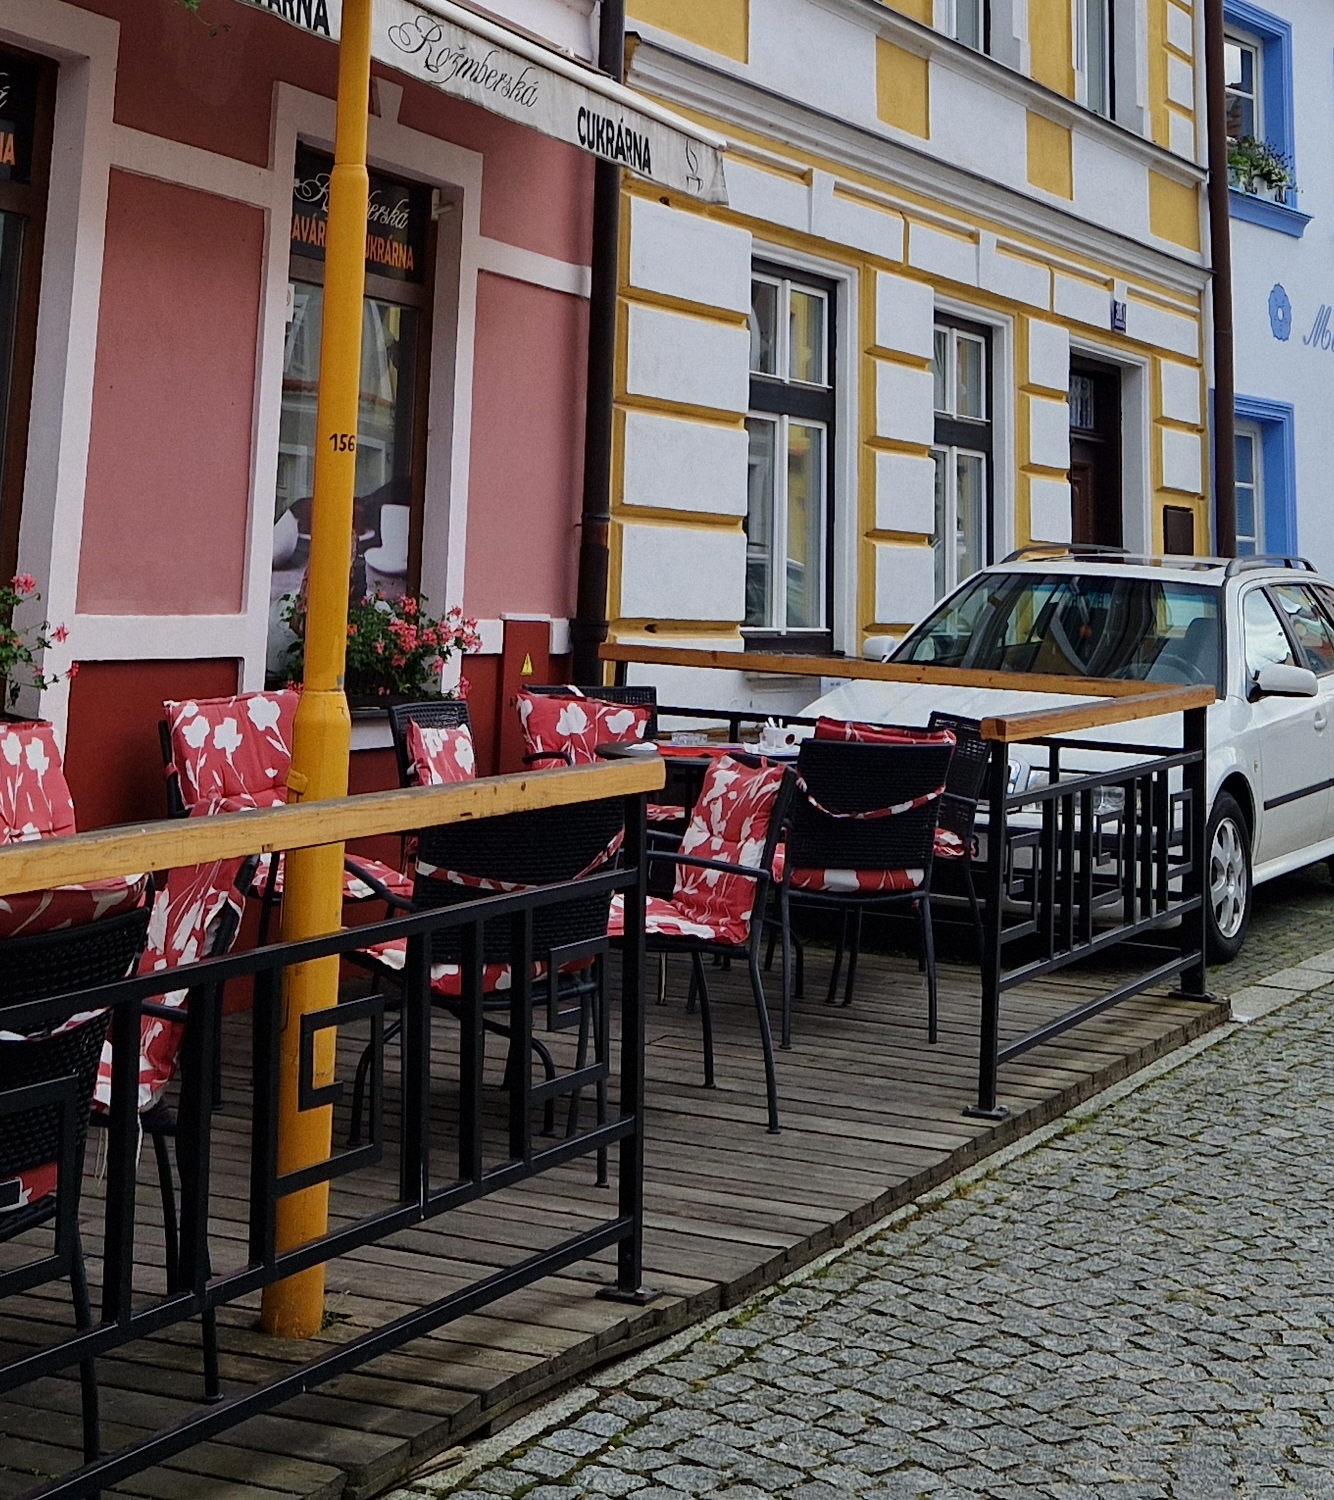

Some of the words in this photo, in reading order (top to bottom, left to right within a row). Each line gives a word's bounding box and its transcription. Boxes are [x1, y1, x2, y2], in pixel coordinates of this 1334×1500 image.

[388, 14, 539, 108] Rožmberská
[577, 105, 652, 175] CUKRÁRNA
[329, 433, 356, 452] 156
